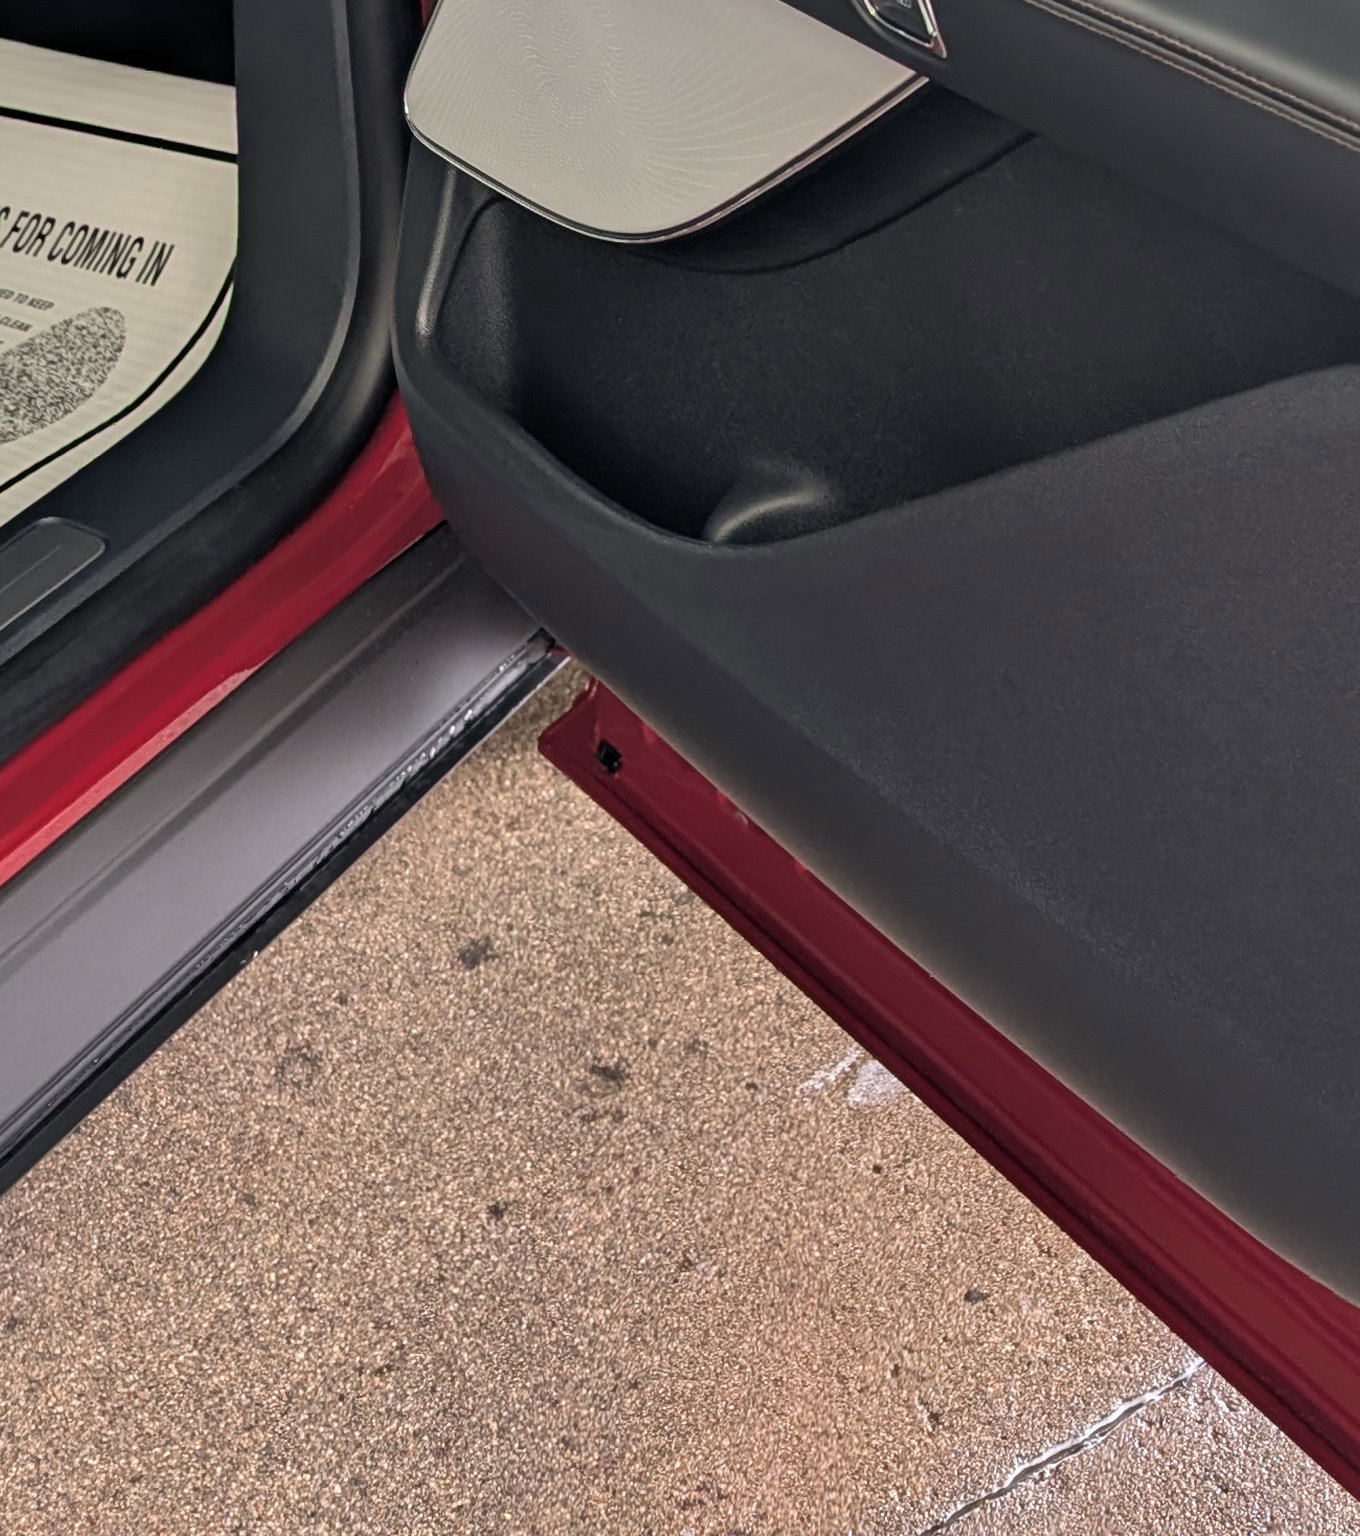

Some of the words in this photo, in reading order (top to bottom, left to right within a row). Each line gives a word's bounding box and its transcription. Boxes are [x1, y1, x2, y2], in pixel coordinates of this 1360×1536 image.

[0, 210, 56, 257] FOR
[47, 221, 144, 279] COMING
[135, 241, 175, 287] IN
[13, 293, 30, 304] TO
[28, 298, 55, 311] KEEP
